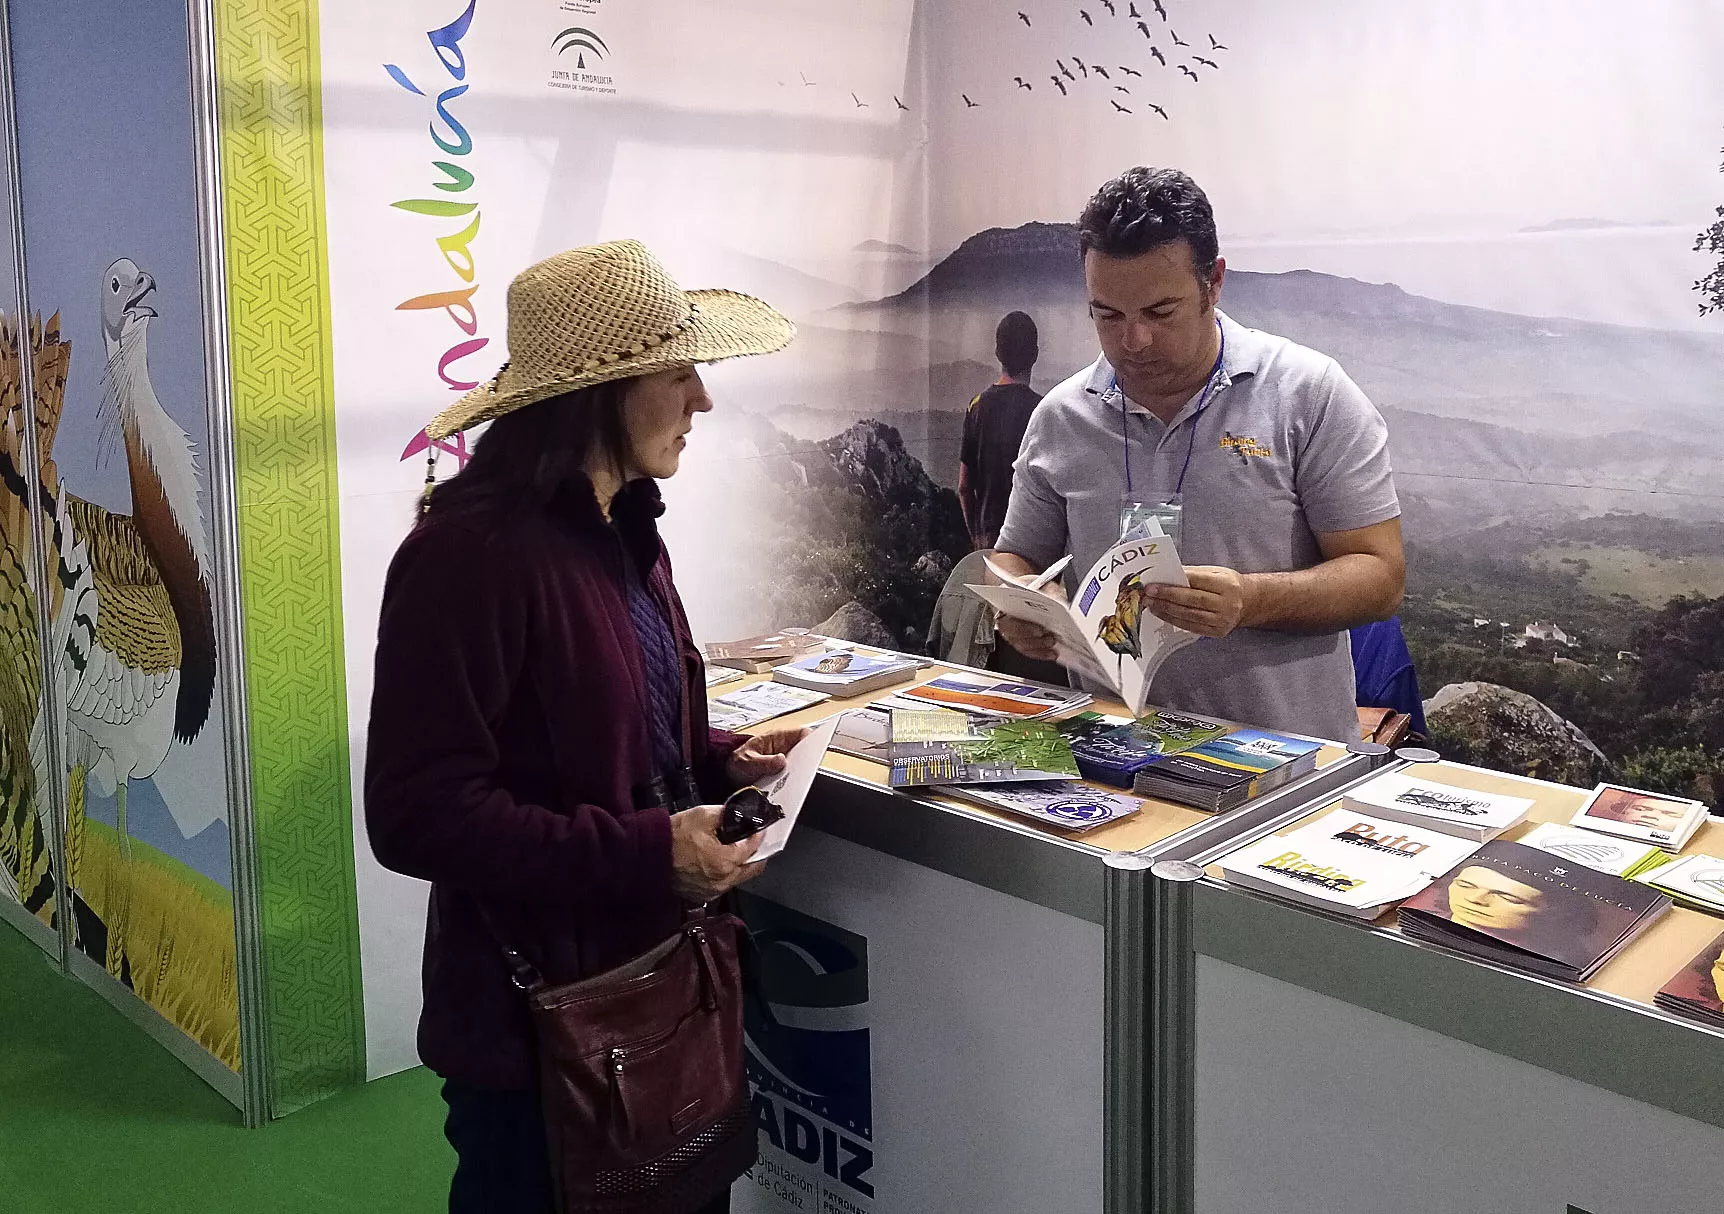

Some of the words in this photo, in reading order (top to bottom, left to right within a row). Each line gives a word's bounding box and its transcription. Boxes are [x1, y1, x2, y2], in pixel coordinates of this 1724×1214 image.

[552, 70, 569, 80] JUNTA
[572, 73, 579, 81] DE
[1098, 543, 1161, 582] CÁDIZ
[893, 753, 950, 764] OBSERVATORIOS
[1344, 822, 1430, 856] Ruta
[1263, 851, 1367, 891] Birding
[1472, 854, 1508, 866] RUTA
[1515, 865, 1554, 882] PACO
[1559, 882, 1577, 891] DE
[751, 1089, 874, 1200] ADIZ
[757, 1151, 813, 1195] Diputación
[757, 1173, 771, 1190] de
[774, 1179, 803, 1209] Cádiz
[823, 1189, 869, 1214] PATRONAT
